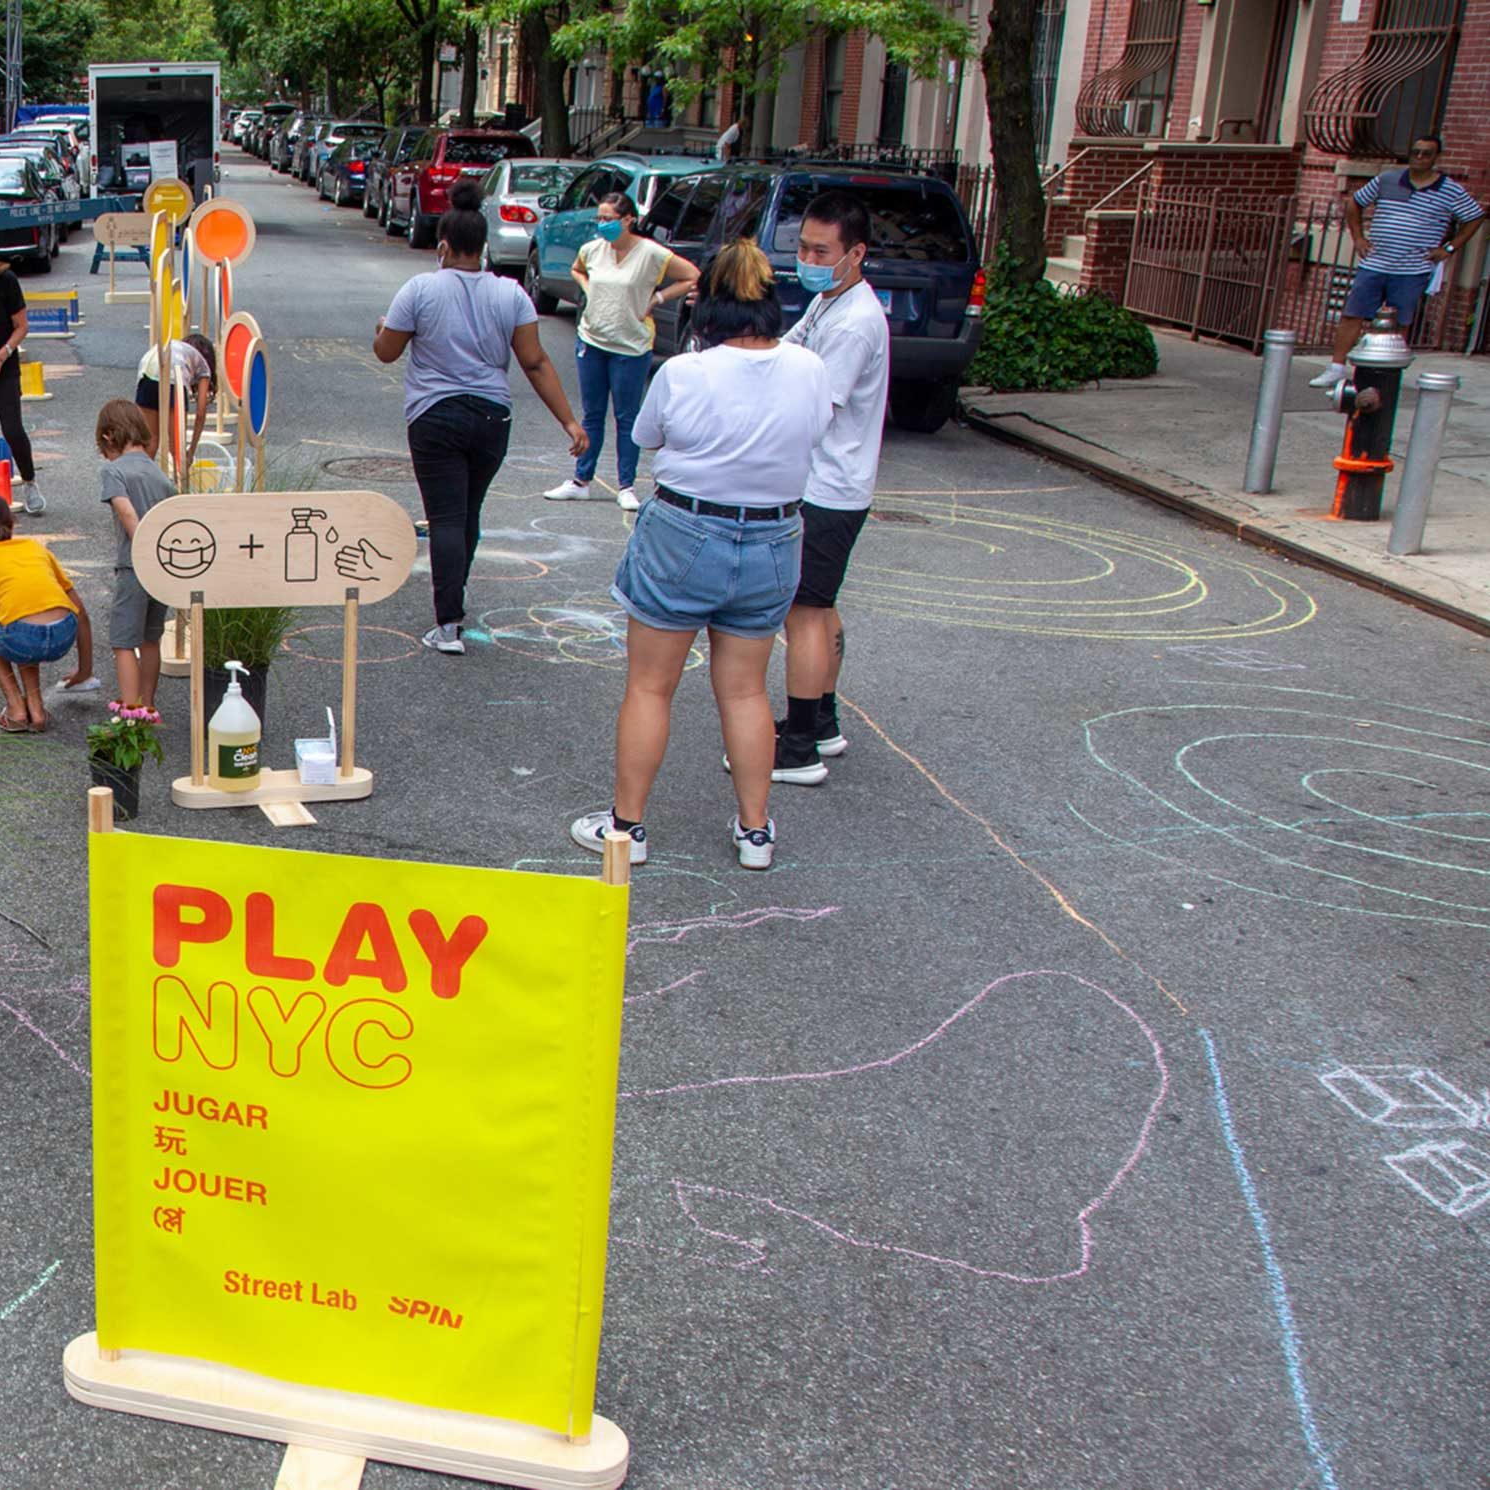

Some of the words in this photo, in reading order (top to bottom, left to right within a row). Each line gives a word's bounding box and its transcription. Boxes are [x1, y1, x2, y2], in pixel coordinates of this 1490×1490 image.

[10, 207, 27, 218] POLICE
[30, 206, 41, 216] LINE
[55, 203, 63, 213] NOT
[65, 202, 81, 212] CROSS
[37, 214, 54, 222] NYPD
[152, 883, 489, 1000] PLAY
[152, 974, 414, 1089] NYC
[153, 1089, 268, 1130] JUGAR
[153, 1125, 187, 1156] 玩
[153, 1167, 267, 1206] JOUER
[223, 1270, 303, 1302] Street
[311, 1282, 357, 1311] Lab
[387, 1296, 463, 1329] SPIN
